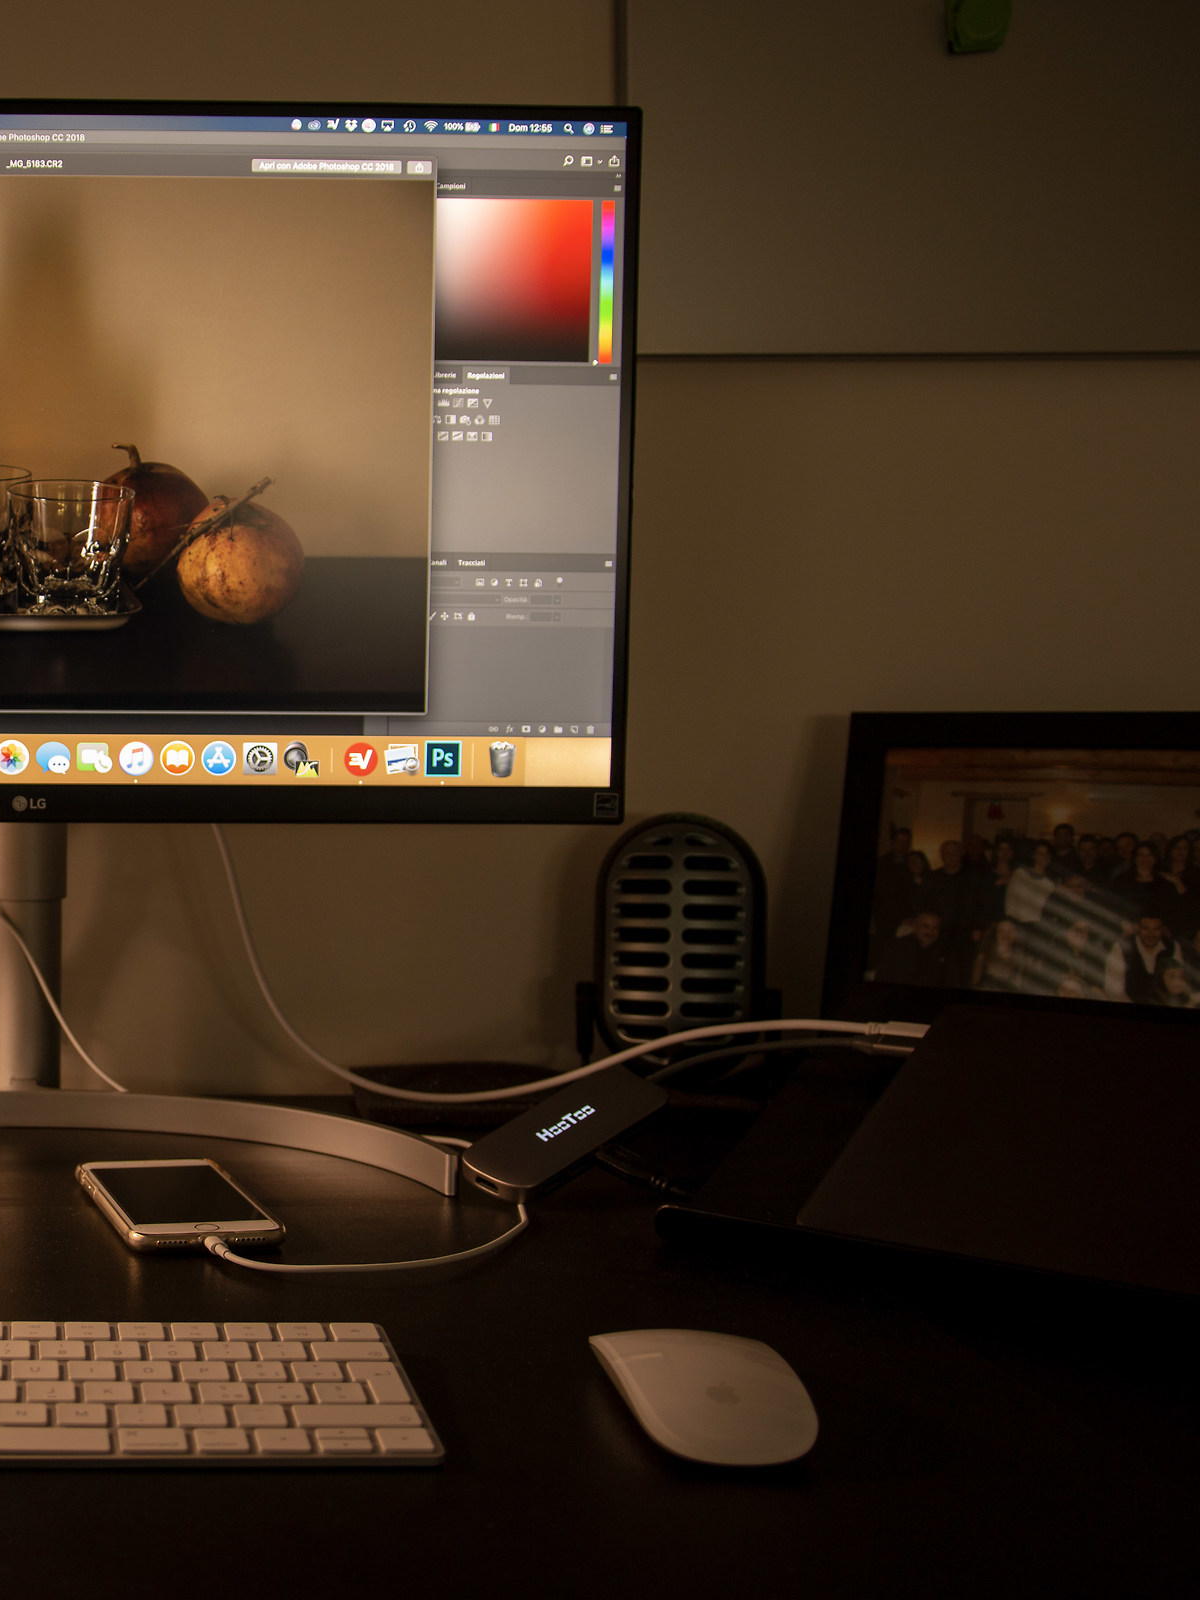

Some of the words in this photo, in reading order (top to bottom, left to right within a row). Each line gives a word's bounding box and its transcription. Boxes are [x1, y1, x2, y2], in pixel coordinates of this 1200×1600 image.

[443, 123, 464, 131] 100%
[508, 123, 528, 132] Dom
[8, 133, 50, 143] Photoshop
[66, 134, 85, 142] 2018
[259, 162, 275, 171] Apri
[293, 162, 317, 171] Adobe
[319, 162, 360, 172] Photoshop
[361, 163, 373, 171] CC
[375, 163, 395, 171] 2018
[434, 371, 456, 379] ibrerie
[466, 371, 505, 380] Regolazioni
[442, 387, 480, 395] regolazione
[432, 748, 454, 768] Ps
[29, 798, 47, 809] LG
